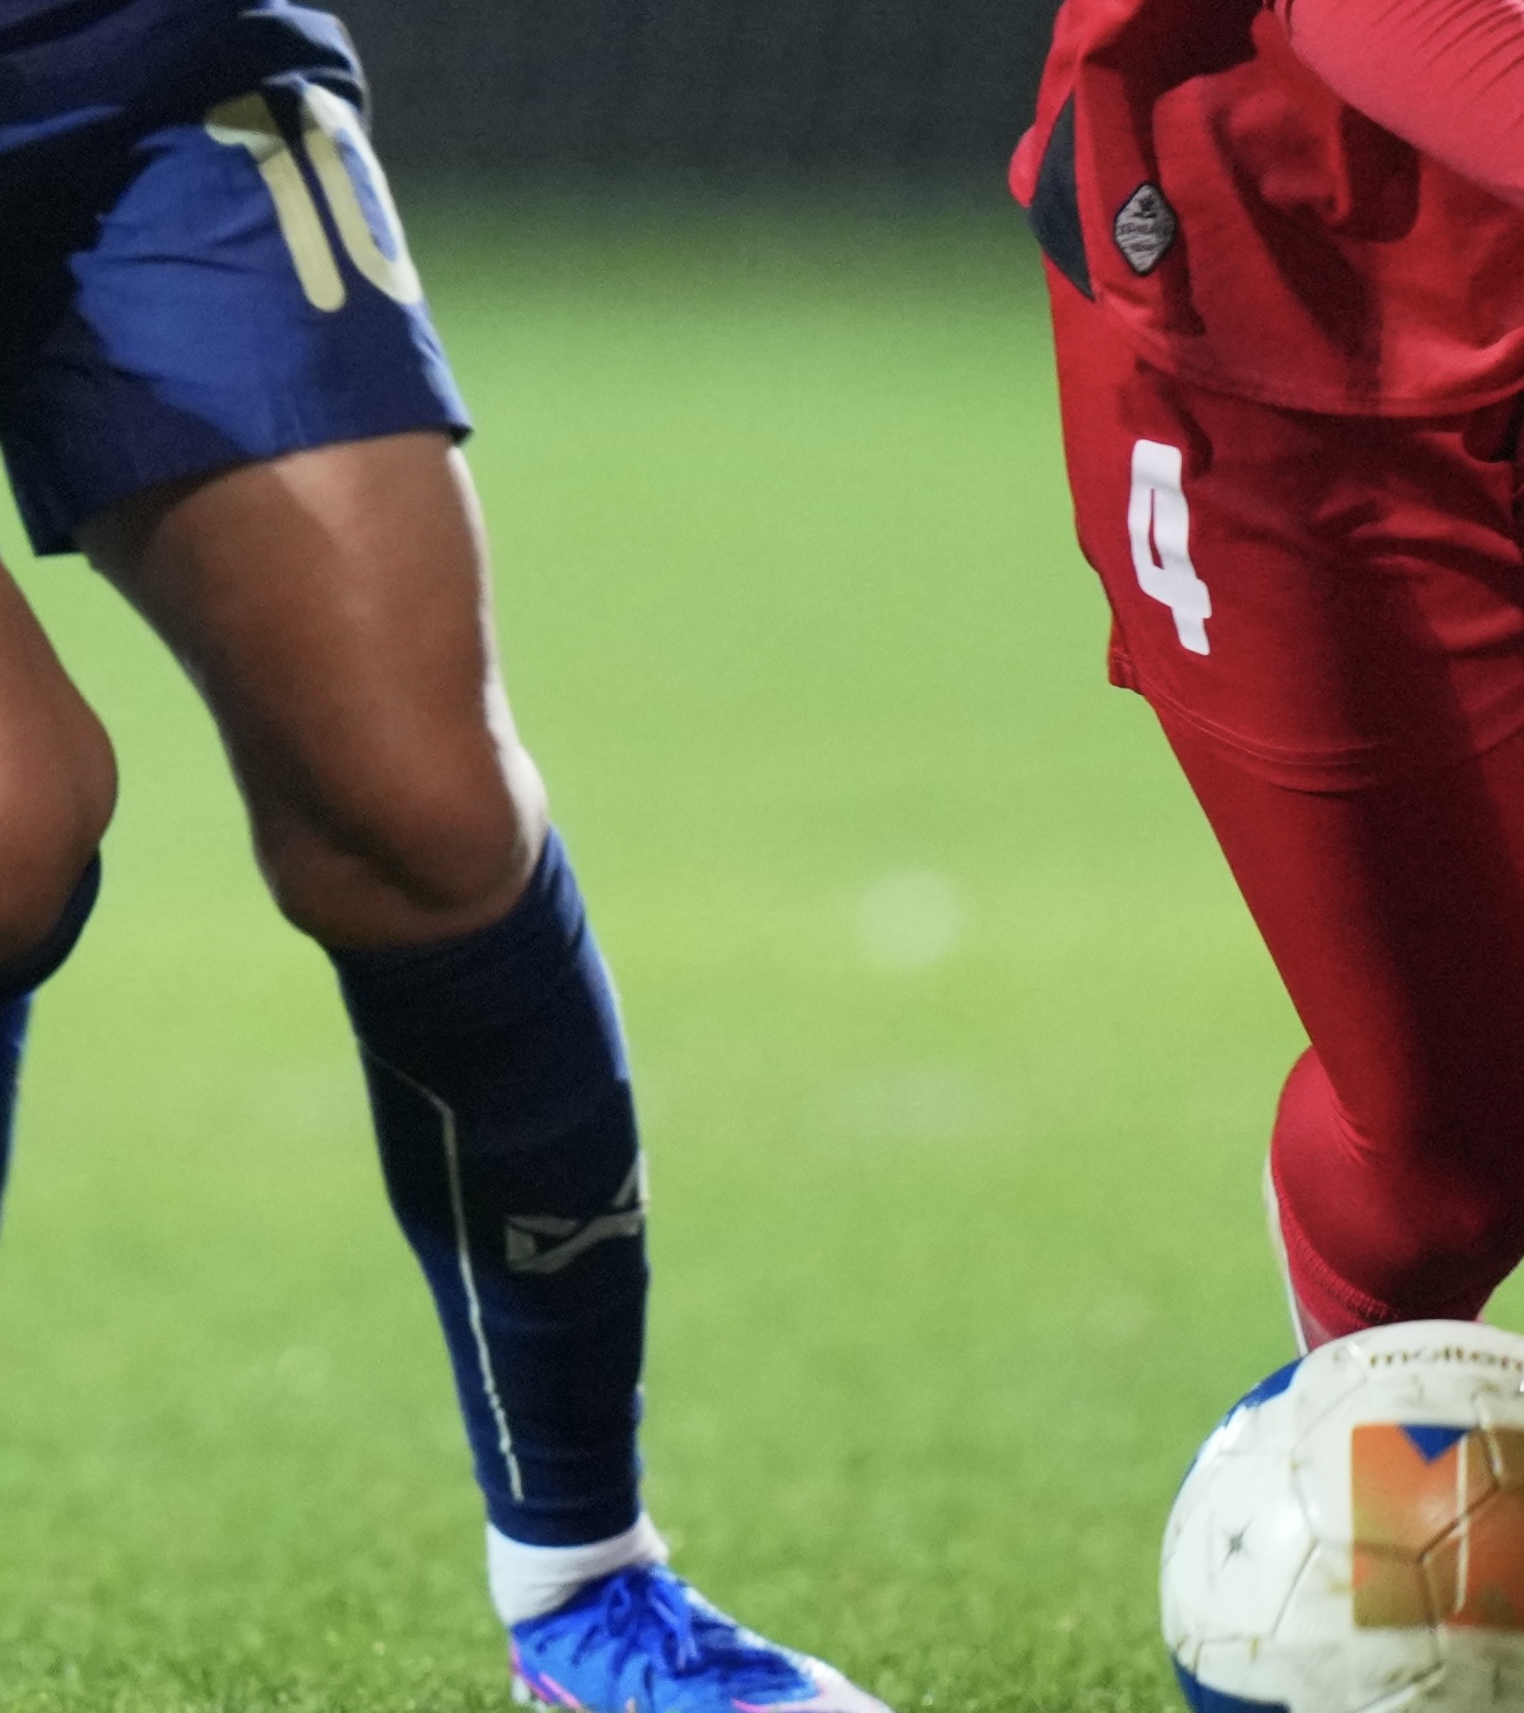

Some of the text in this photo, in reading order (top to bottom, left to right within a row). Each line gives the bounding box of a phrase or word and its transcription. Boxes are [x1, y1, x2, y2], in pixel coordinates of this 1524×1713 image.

[205, 84, 423, 313] 10
[1128, 438, 1212, 656] 4
[1370, 1346, 1524, 1372] molten
